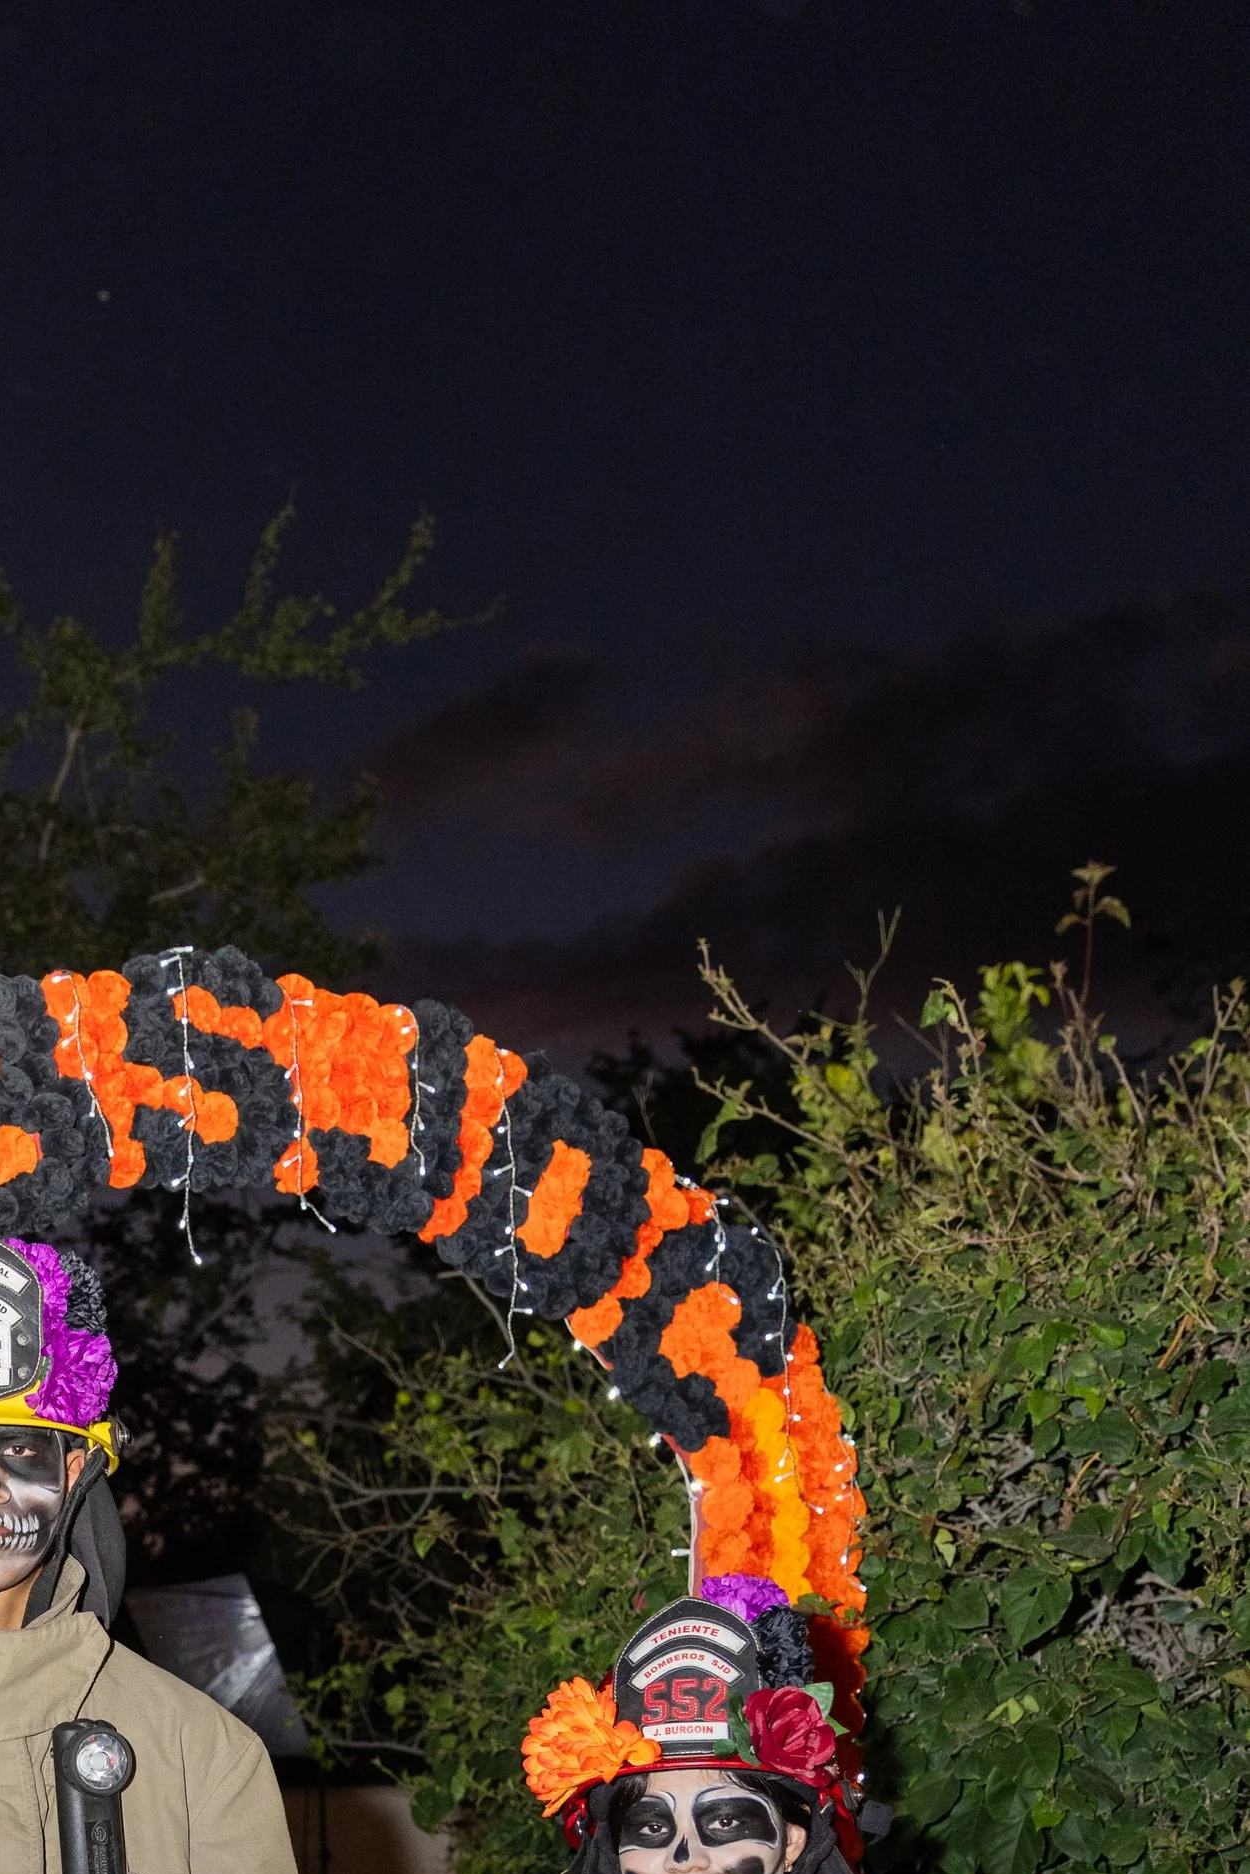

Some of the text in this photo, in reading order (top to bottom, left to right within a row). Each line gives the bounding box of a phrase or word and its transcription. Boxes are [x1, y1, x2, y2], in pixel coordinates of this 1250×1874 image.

[651, 1625, 720, 1645] TENIENTE
[643, 1653, 732, 1679] BOMBEROS SJD
[641, 1677, 728, 1725] 552
[653, 1725, 714, 1737] J. BURGOIN
